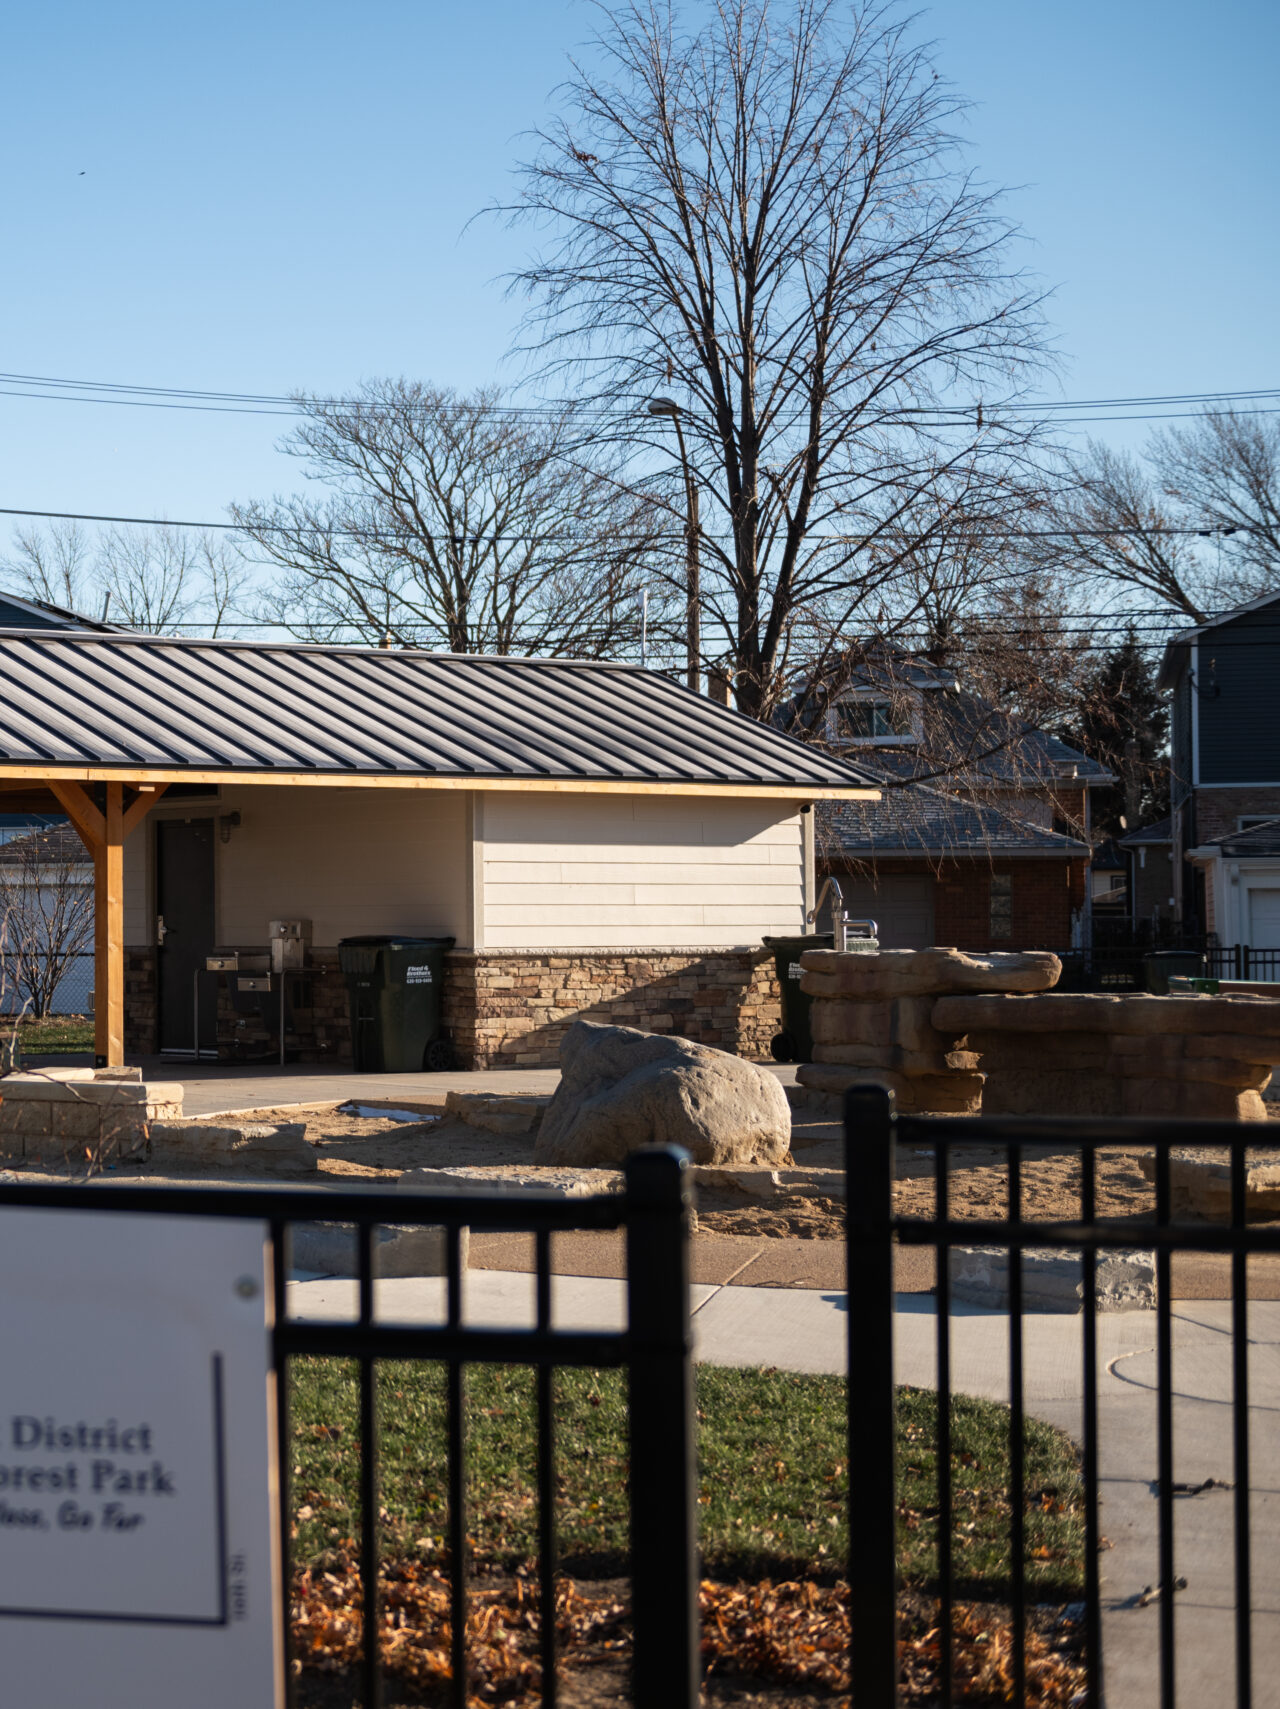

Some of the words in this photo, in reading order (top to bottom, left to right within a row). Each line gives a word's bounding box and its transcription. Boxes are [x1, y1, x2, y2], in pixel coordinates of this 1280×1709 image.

[11, 1414, 153, 1454] District
[90, 1458, 175, 1497] Park
[56, 1498, 96, 1532] Go
